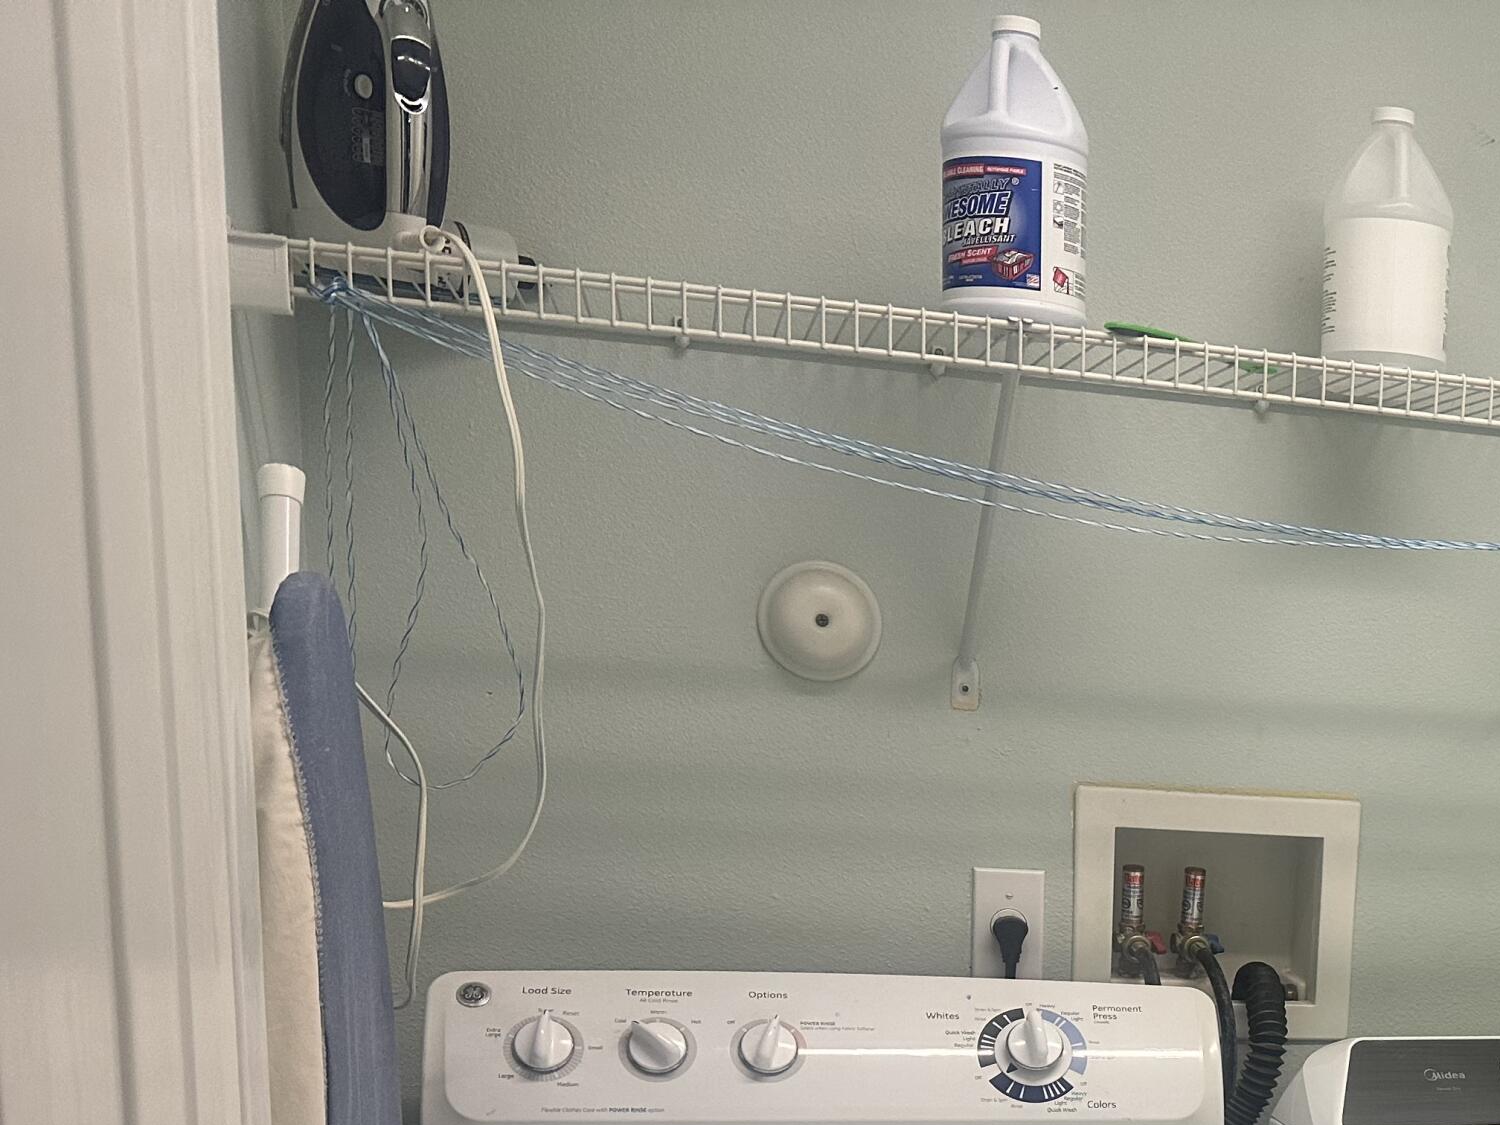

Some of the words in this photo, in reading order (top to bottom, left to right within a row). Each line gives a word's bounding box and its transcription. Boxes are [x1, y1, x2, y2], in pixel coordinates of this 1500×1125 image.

[967, 247, 993, 257] SCENT
[522, 986, 548, 995] Load
[550, 987, 572, 995] Size
[625, 988, 693, 998] Temperature
[748, 991, 788, 1000] Options
[1092, 1004, 1143, 1013] Permanent
[925, 1012, 960, 1020] Whites
[1424, 1068, 1466, 1081] Midea
[1087, 1100, 1117, 1109] Colors
